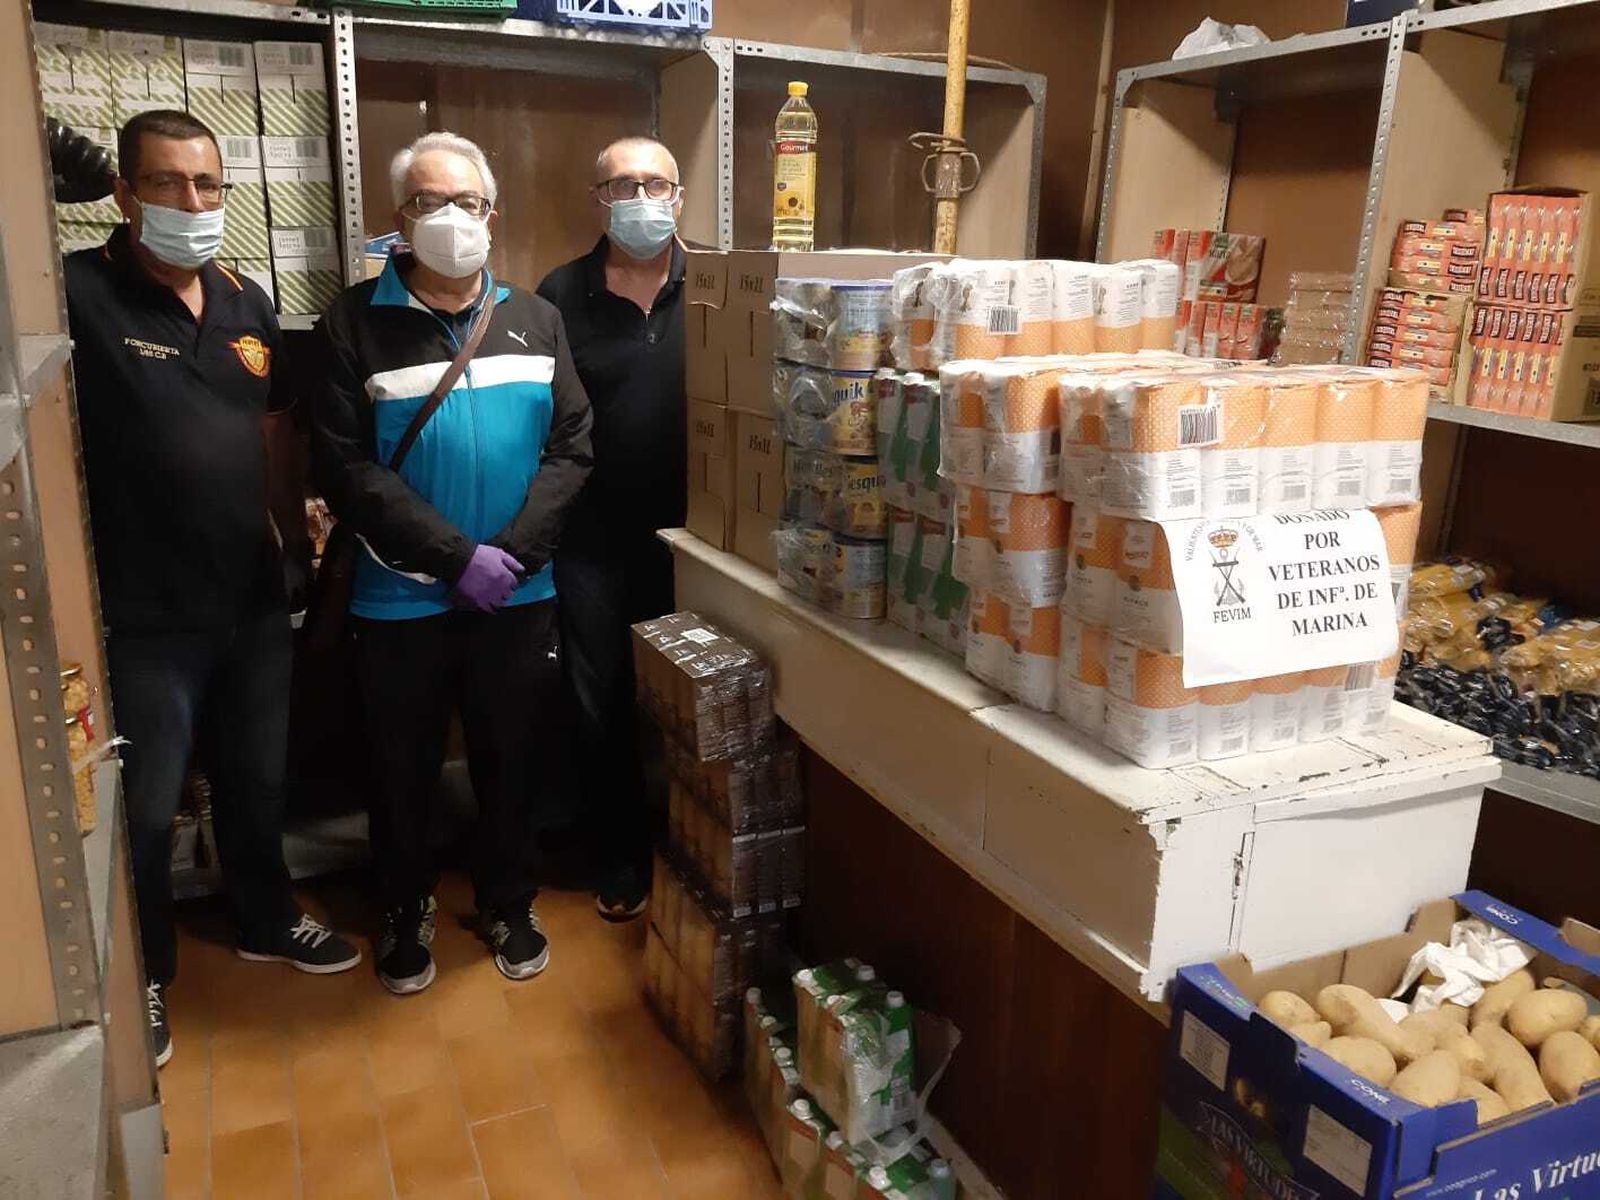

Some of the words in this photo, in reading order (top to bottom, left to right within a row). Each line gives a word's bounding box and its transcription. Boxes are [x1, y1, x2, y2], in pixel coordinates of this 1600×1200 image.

[834, 382, 864, 405] quik
[1273, 509, 1350, 526] DONADO
[1304, 531, 1341, 550] POR
[1268, 554, 1381, 582] VETERANOS
[1277, 590, 1304, 610] DE
[1354, 582, 1379, 601] DE
[1213, 607, 1252, 624] FEVIM
[1292, 611, 1368, 637] MARINA
[1532, 1151, 1600, 1194] Virtu
